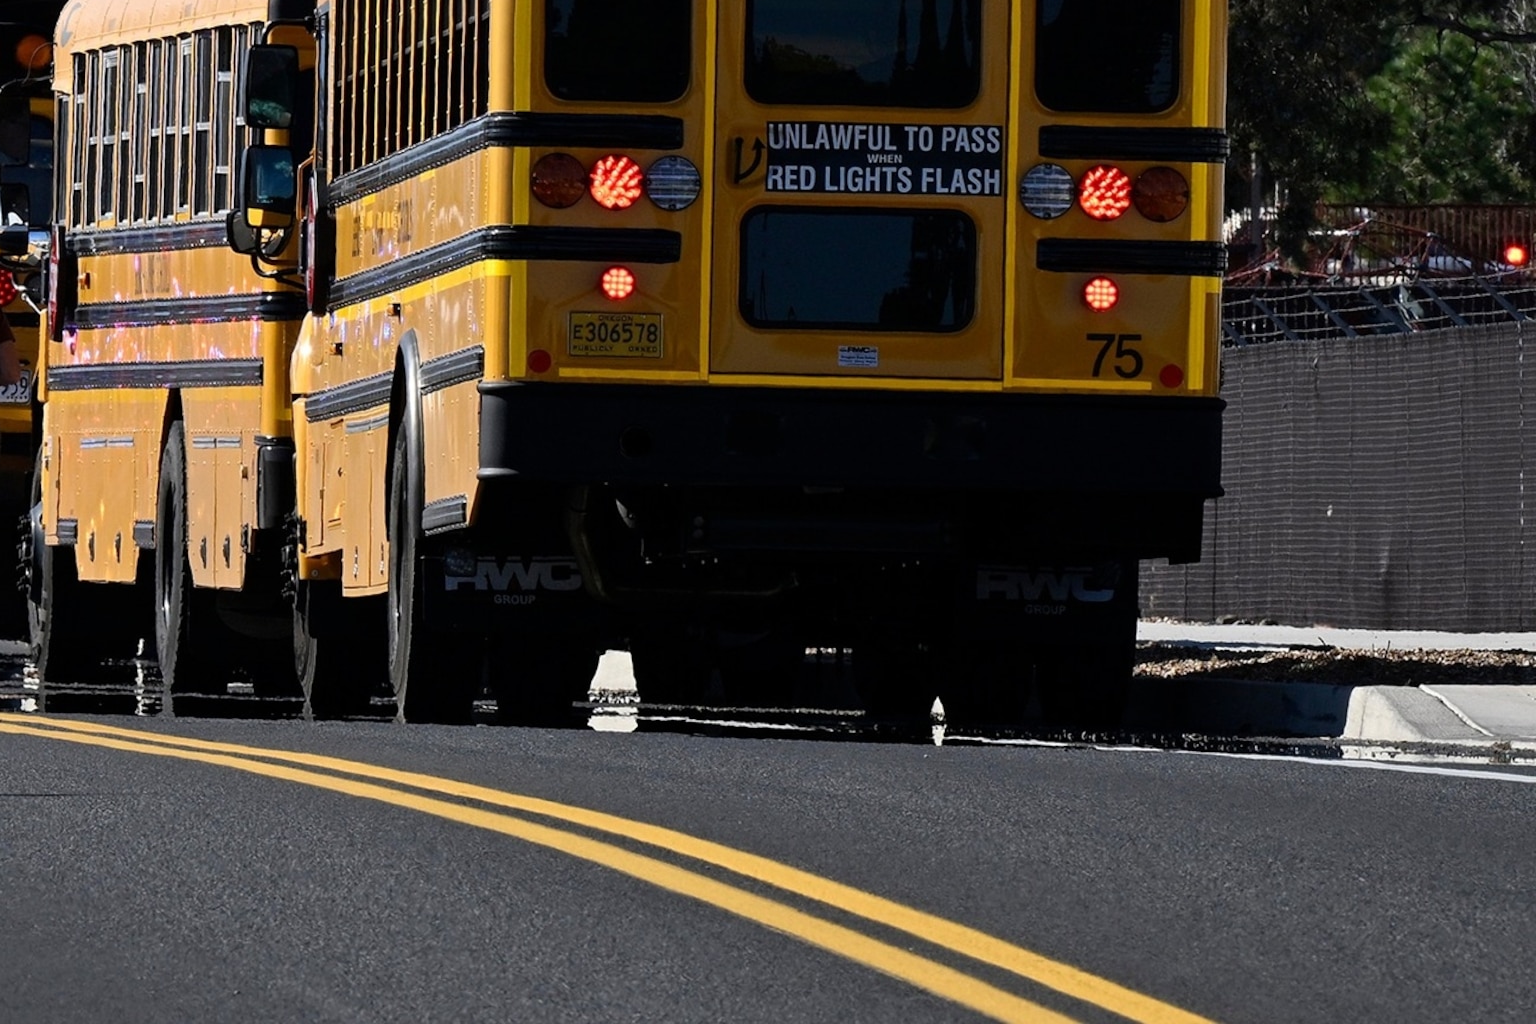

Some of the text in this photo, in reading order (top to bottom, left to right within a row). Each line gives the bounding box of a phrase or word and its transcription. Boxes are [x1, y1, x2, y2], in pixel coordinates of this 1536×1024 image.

[768, 123, 1001, 154] UNLAWFUL TO PASS
[867, 153, 903, 164] WHEN
[767, 165, 1001, 195] RED LIGHTS FLASH
[573, 321, 658, 344] E306578
[1086, 333, 1144, 379] 75
[493, 593, 537, 607] GROUP
[1024, 604, 1066, 616] GROUP
